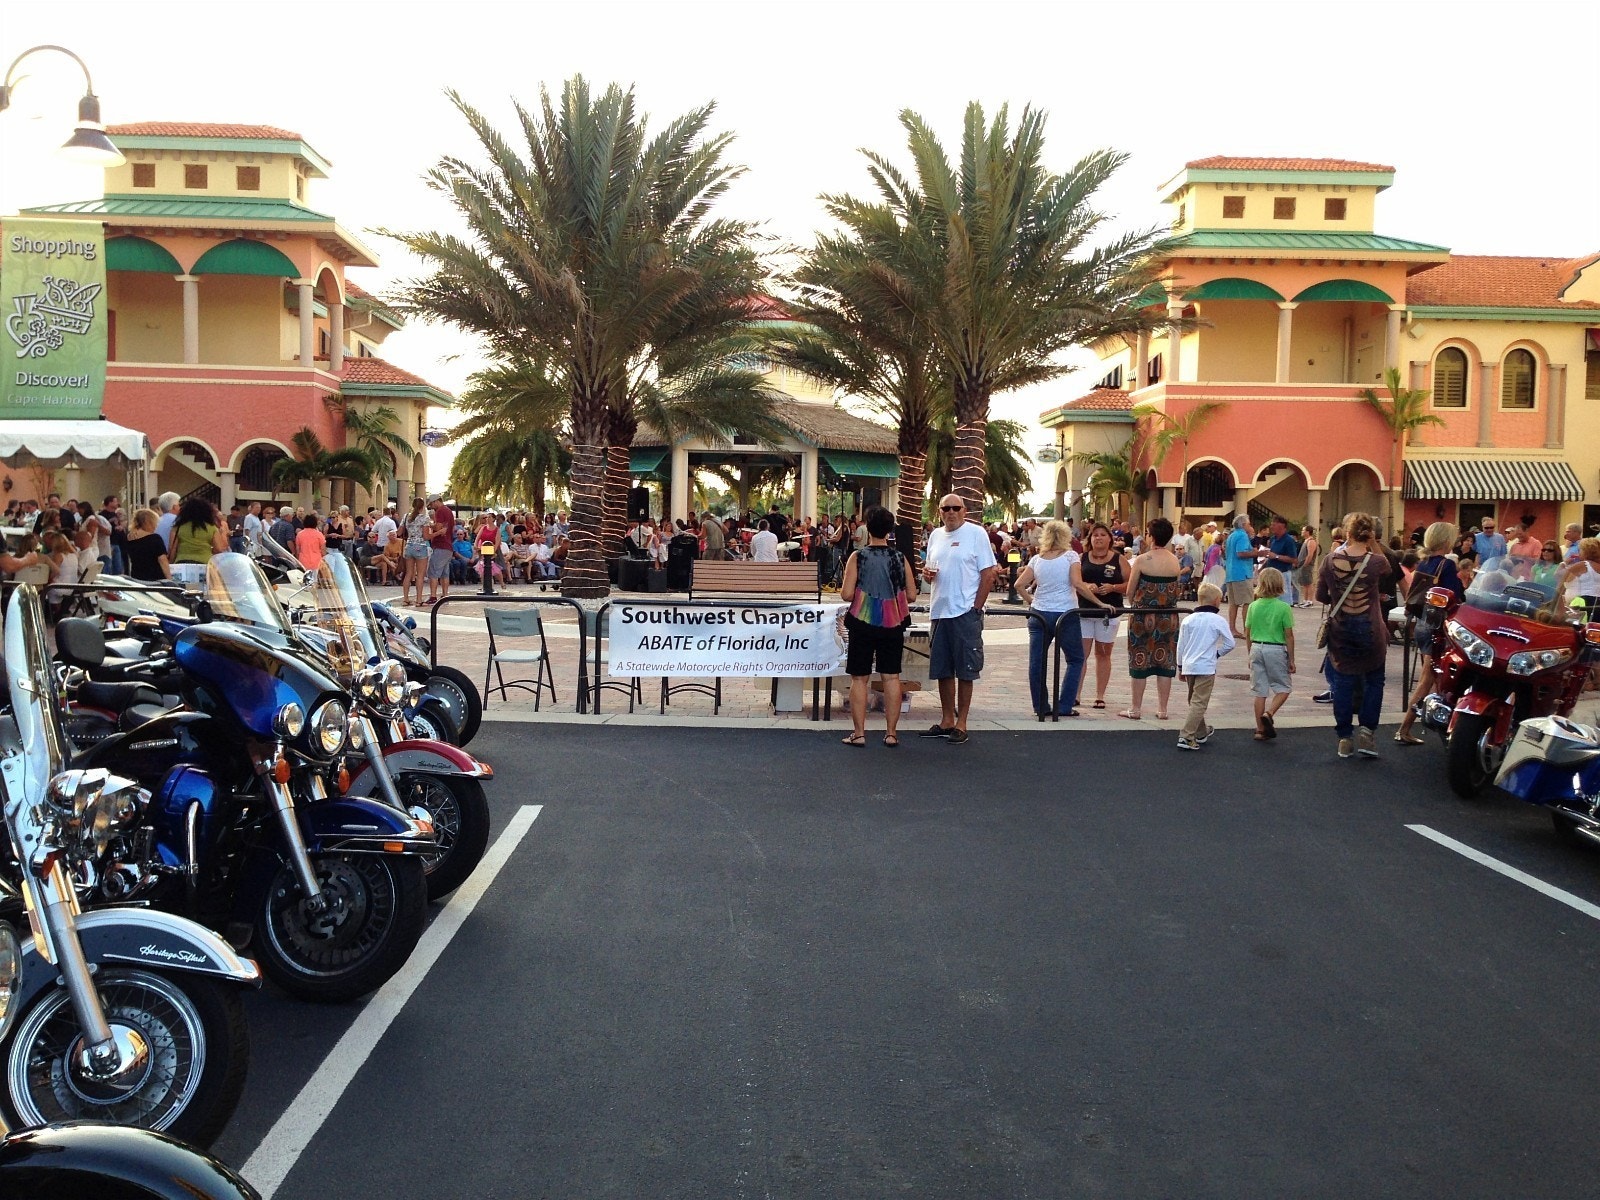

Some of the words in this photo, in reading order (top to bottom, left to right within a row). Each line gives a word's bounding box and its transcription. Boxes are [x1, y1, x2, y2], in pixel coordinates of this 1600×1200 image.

[12, 236, 96, 260] Shopping
[15, 371, 89, 388] Discover!
[7, 393, 38, 406] Cape
[42, 394, 93, 406] Harbour
[621, 606, 736, 625] Southwest
[741, 608, 825, 629] Chapter
[637, 635, 694, 650] ABATE
[696, 635, 717, 651] of
[717, 635, 780, 652] Florida,
[784, 634, 810, 650] Inc
[616, 661, 624, 671] A
[625, 661, 675, 672] Statewide
[676, 661, 731, 673] Motorcycle
[732, 661, 763, 674] Rights
[765, 661, 830, 674] Organization
[139, 944, 178, 960] Heritage
